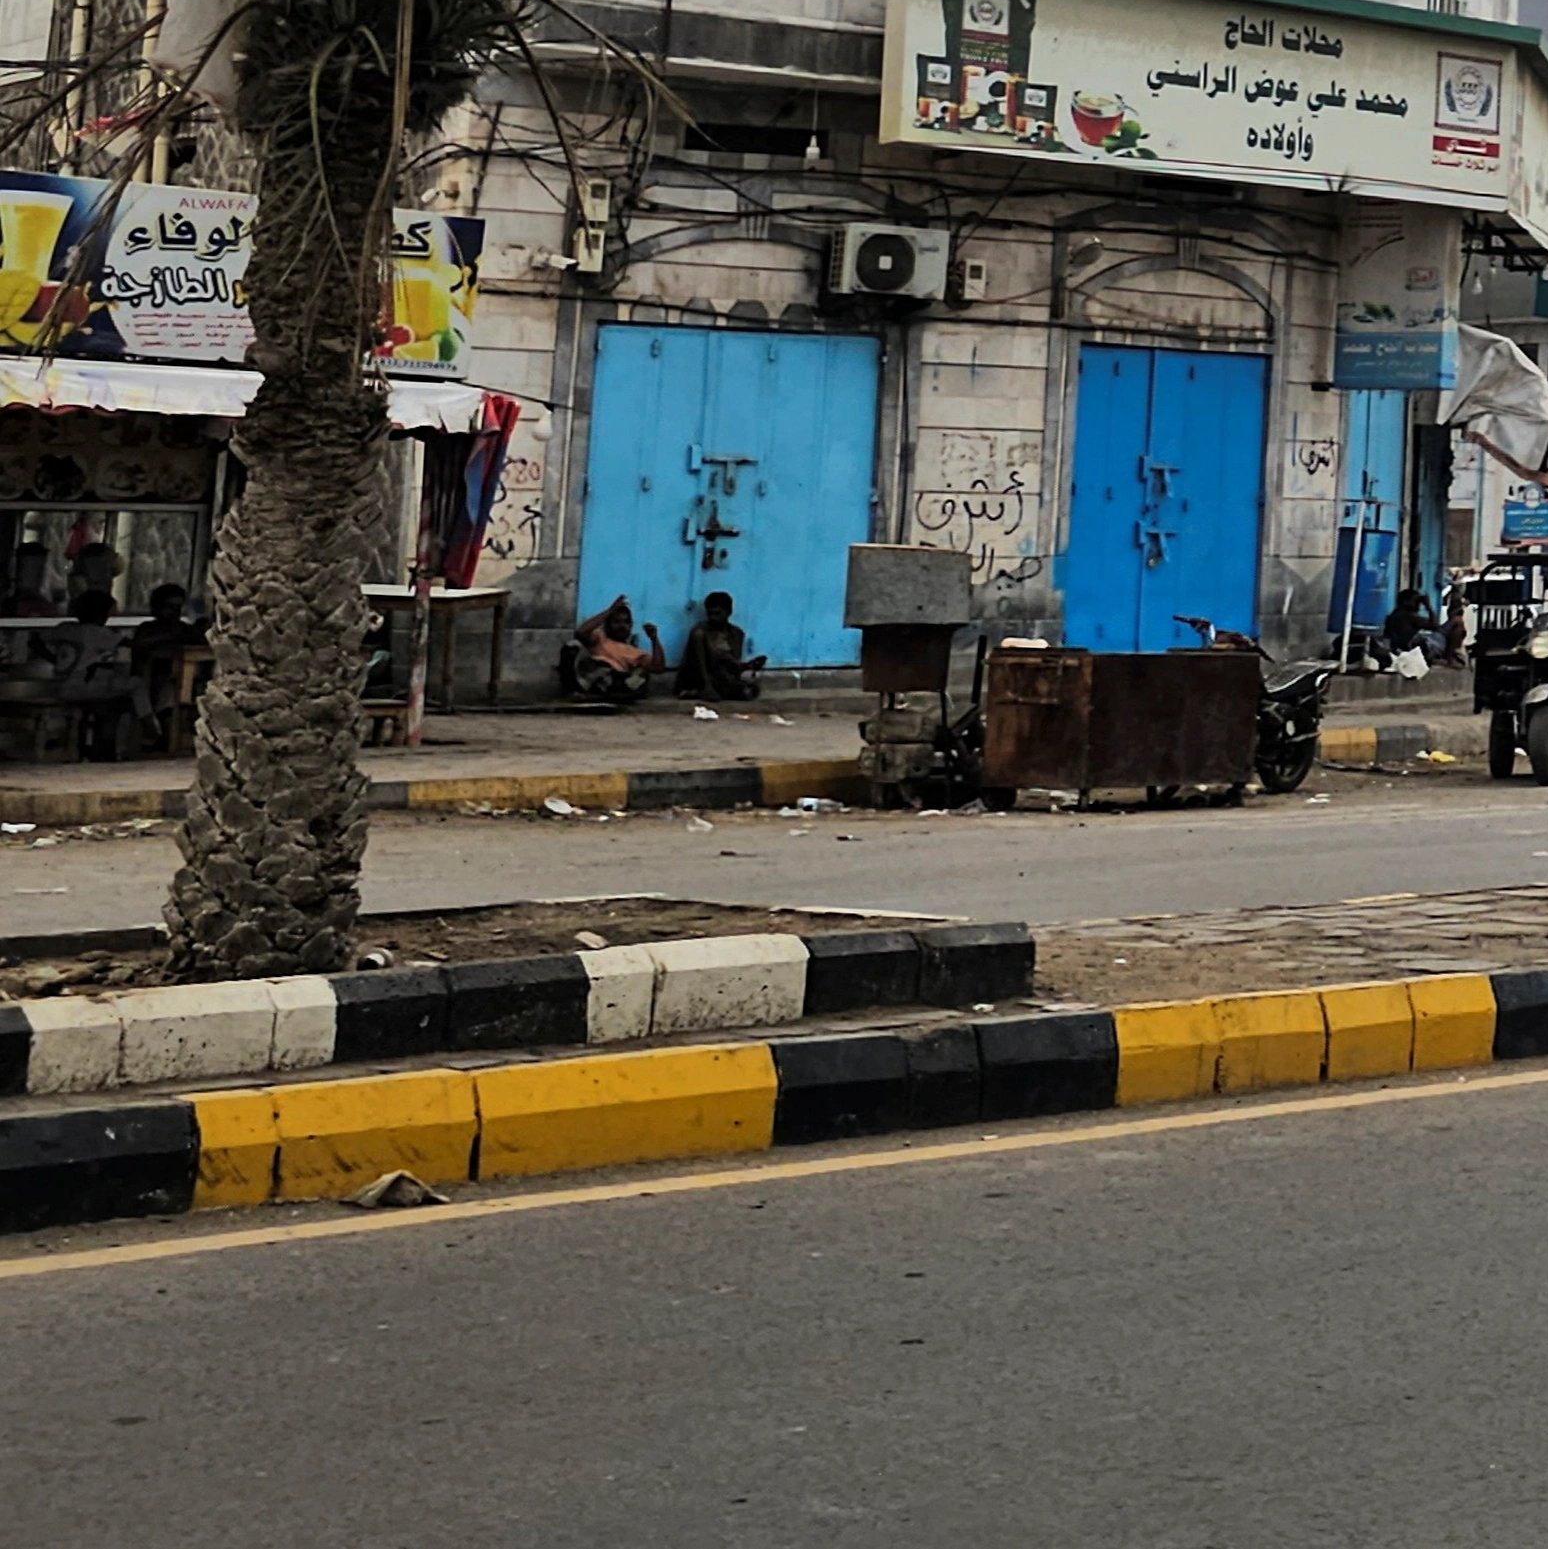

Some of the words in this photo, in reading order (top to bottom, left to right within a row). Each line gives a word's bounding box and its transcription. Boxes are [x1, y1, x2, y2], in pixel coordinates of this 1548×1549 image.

[1224, 15, 1274, 51] الحاج
[1281, 24, 1344, 60] محلات
[1146, 60, 1237, 99] الراسني
[1244, 69, 1299, 108] عوض
[1307, 80, 1347, 118] علي
[1355, 89, 1409, 118] محمد
[1246, 116, 1314, 162] وأولاده
[124, 212, 245, 261] لوفاء
[101, 265, 229, 308] الطازجة
